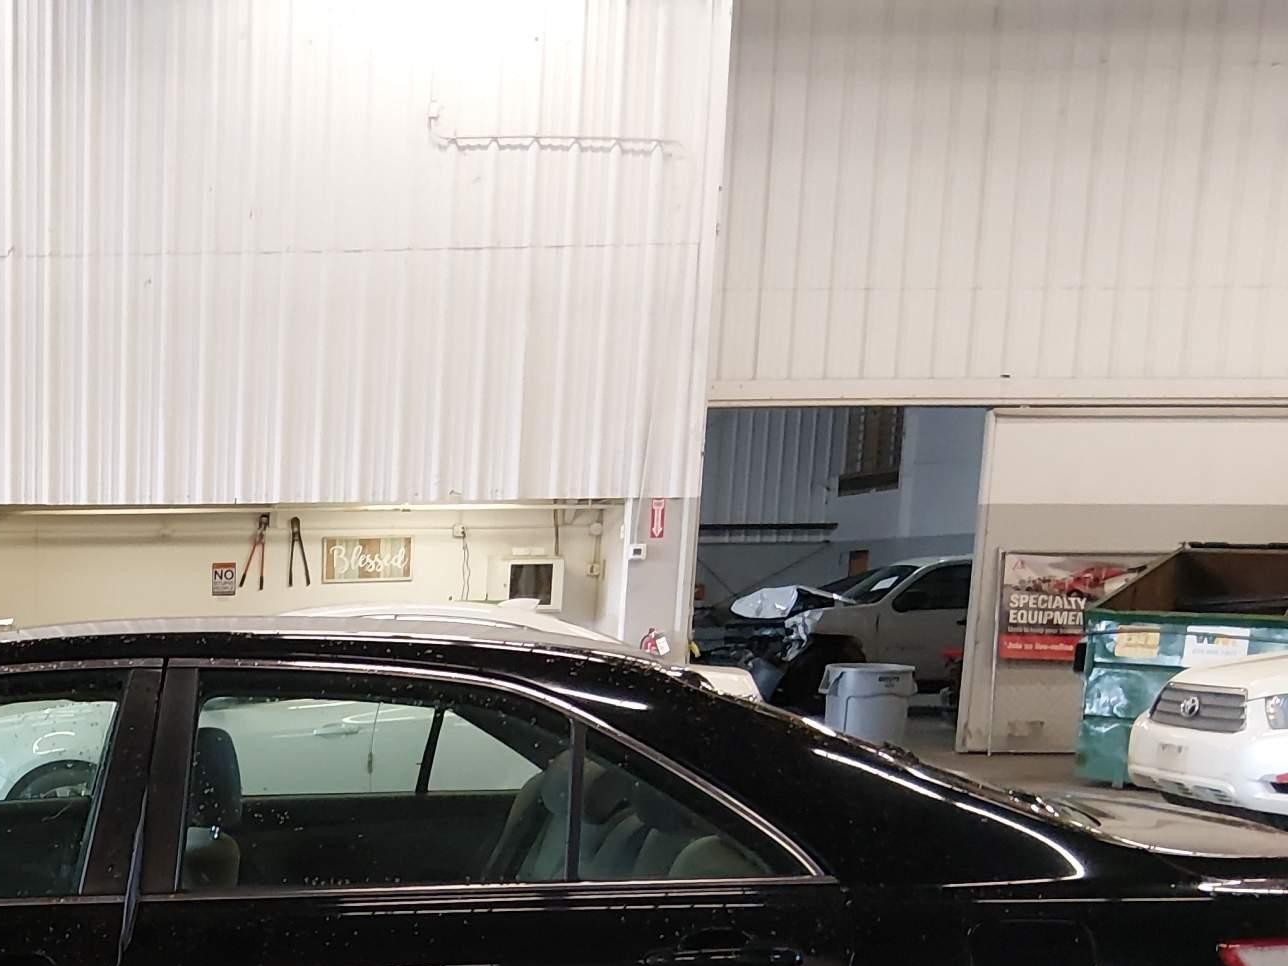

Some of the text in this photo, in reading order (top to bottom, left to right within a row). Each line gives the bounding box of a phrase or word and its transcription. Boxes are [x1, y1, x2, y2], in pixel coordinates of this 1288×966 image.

[329, 545, 409, 574] Blessed
[214, 569, 234, 580] NO
[1009, 594, 1087, 610] SPECIALTY
